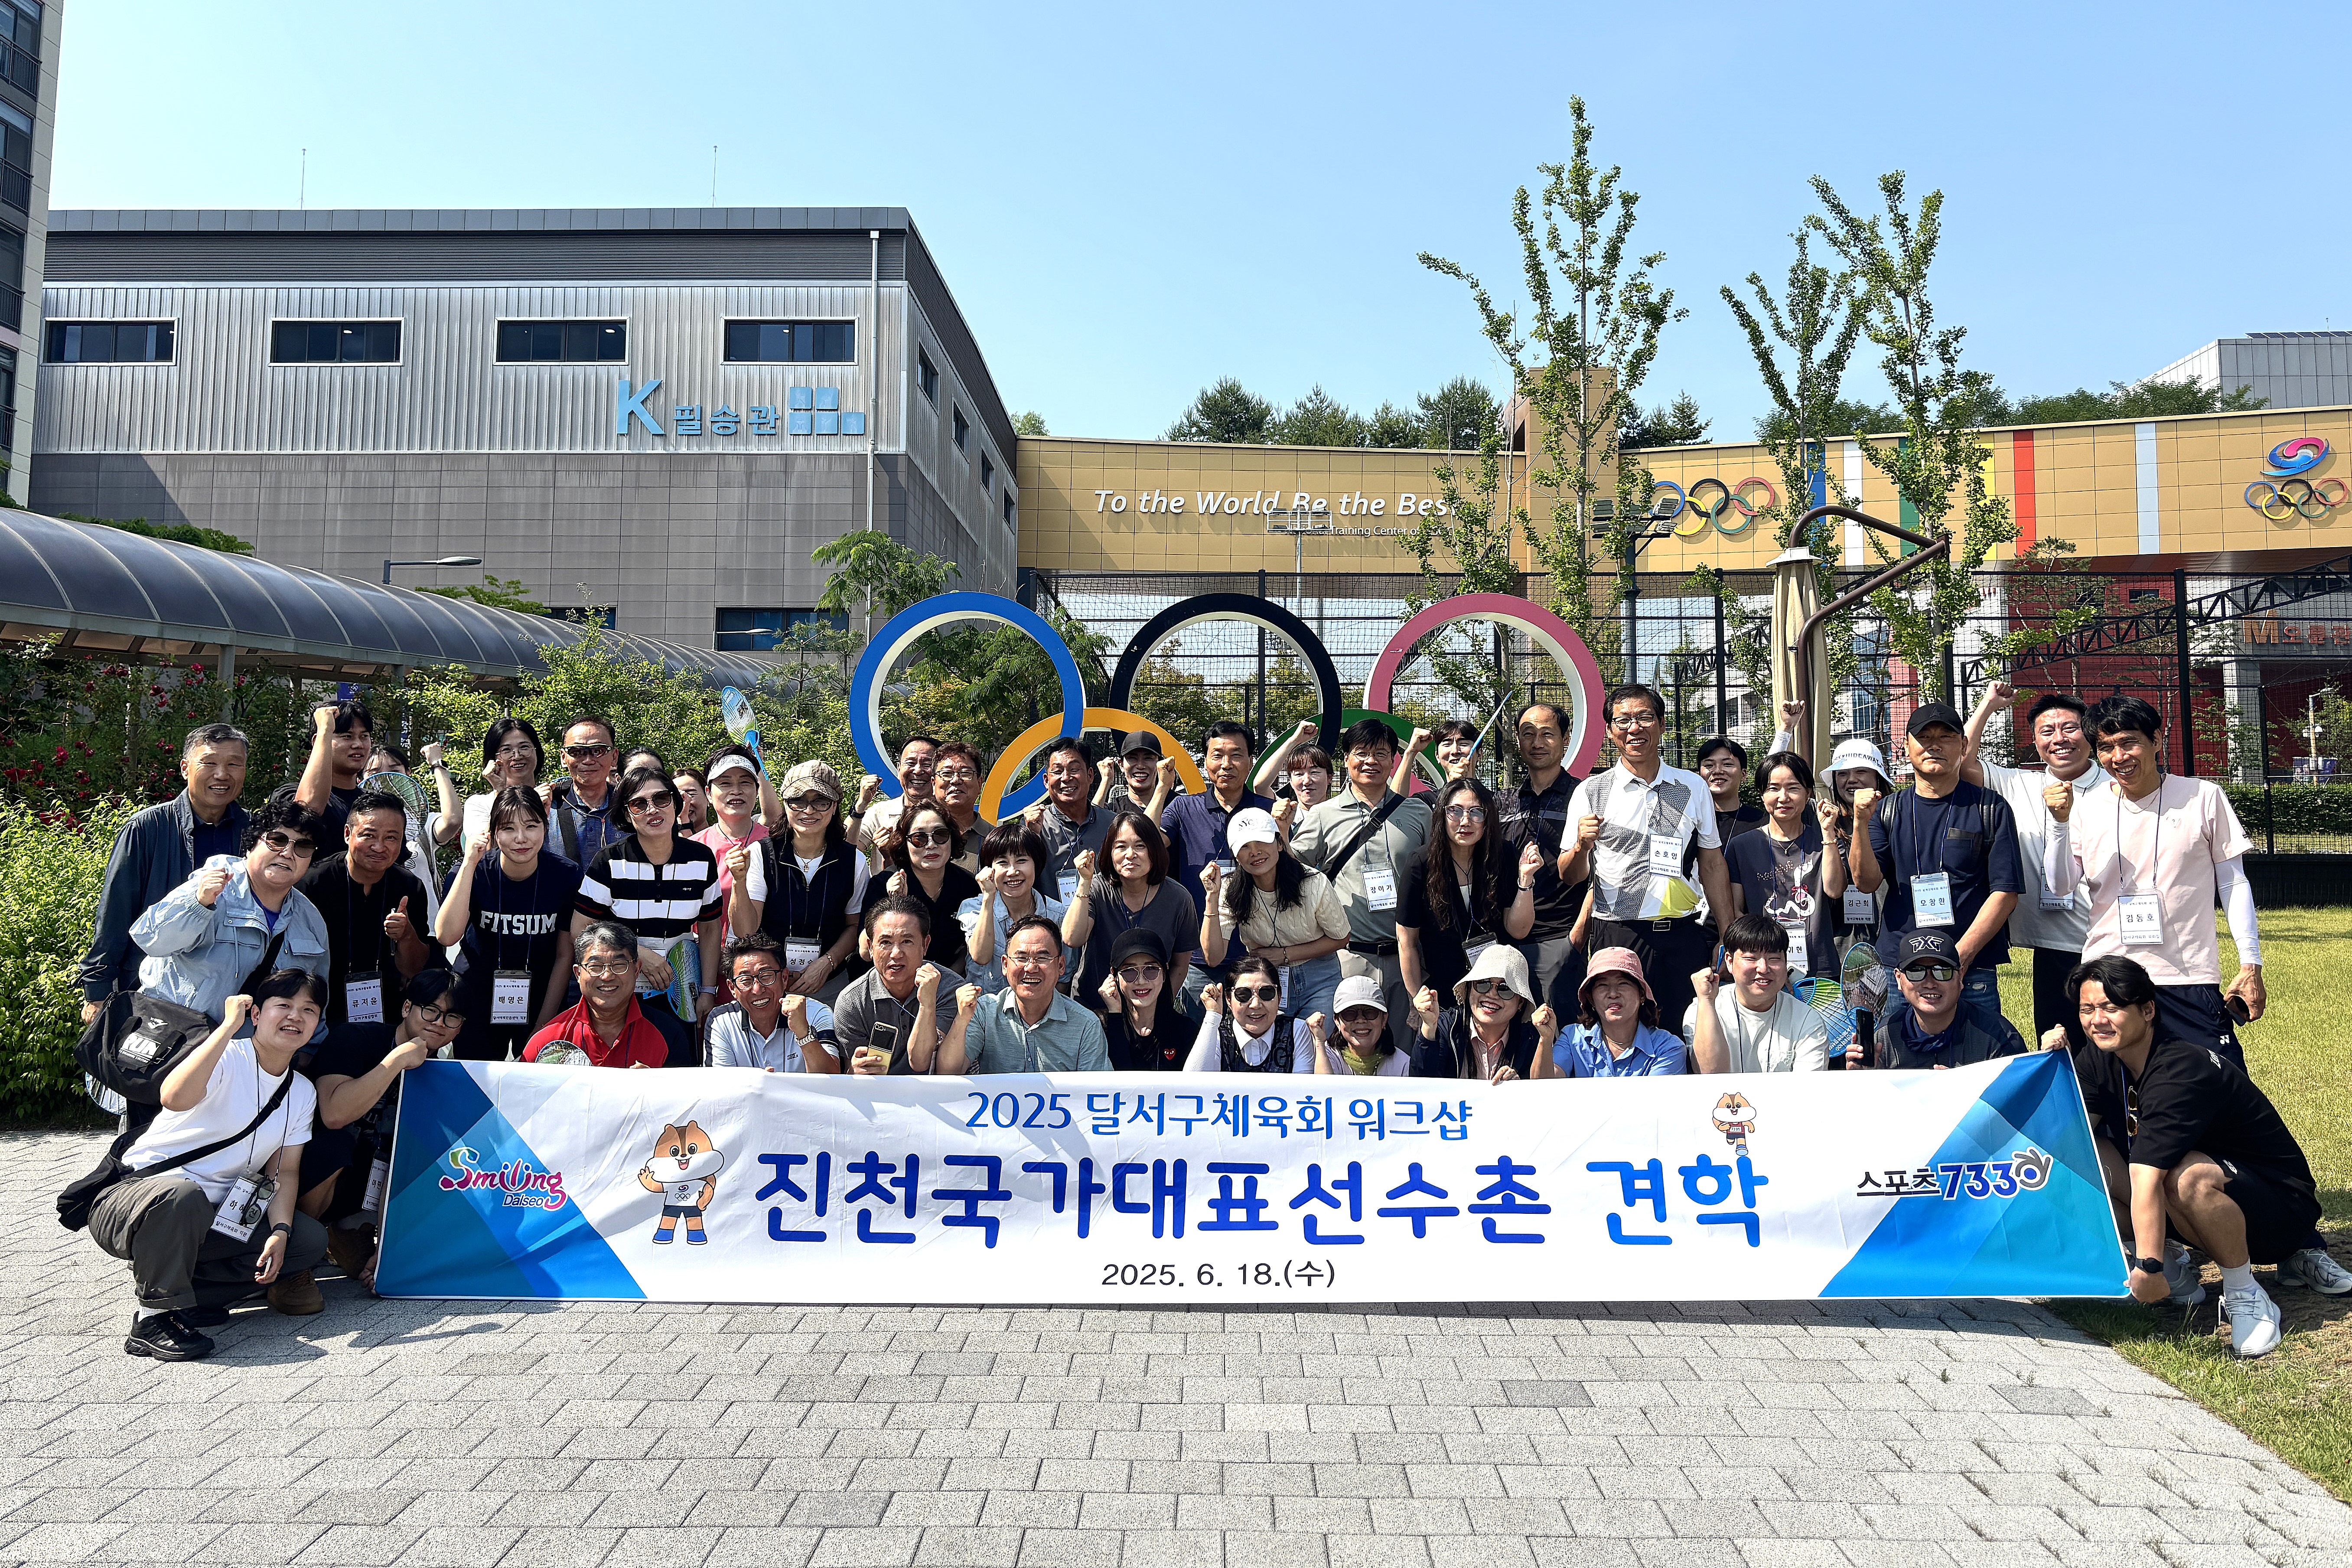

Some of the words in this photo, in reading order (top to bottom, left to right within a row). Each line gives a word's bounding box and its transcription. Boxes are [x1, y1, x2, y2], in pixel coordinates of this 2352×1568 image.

[617, 379, 665, 435] K
[673, 404, 780, 435] 필승관
[1095, 489, 1127, 513] To
[1139, 489, 1185, 514] the
[1196, 490, 1280, 515] World
[1339, 491, 1386, 515] the
[1397, 493, 1456, 516] Bes
[1331, 525, 1371, 537] Training
[1373, 526, 1407, 535] Center
[2242, 609, 2279, 644] M
[480, 910, 557, 935] FITSUM
[2126, 913, 2154, 923] 김동호
[966, 1092, 1072, 1129] 2025
[1086, 1092, 1333, 1139] 달서구체육회
[1349, 1098, 1472, 1141] 워크샵
[439, 1147, 568, 1211] Smiling
[503, 1194, 543, 1206] Dalseo
[755, 1151, 1552, 1249] 진천국가대표선수촌
[1586, 1153, 1770, 1248] 견학
[1101, 1264, 1184, 1287] 2025.
[1197, 1263, 1222, 1287] 6.
[1238, 1259, 1335, 1288] 18.(수)
